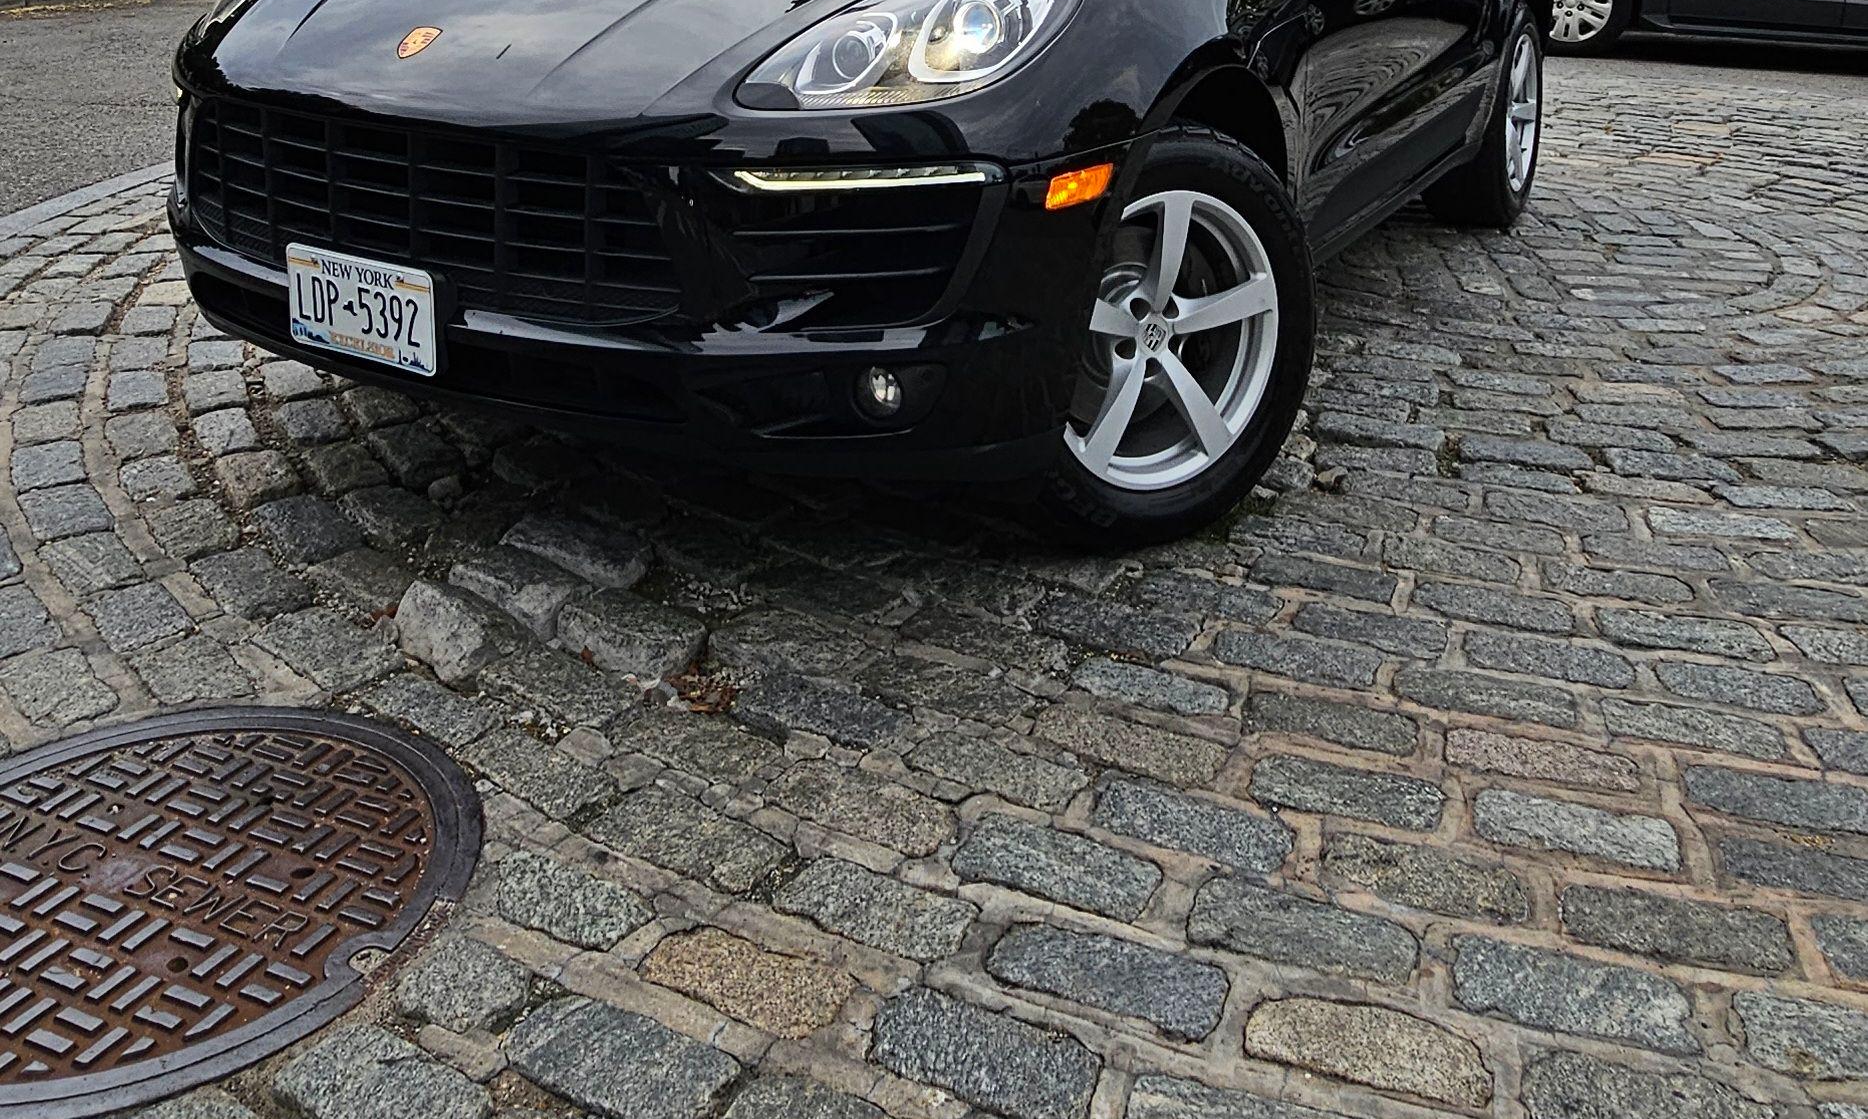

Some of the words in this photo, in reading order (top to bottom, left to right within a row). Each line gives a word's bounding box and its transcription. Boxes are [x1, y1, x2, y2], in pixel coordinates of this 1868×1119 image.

[297, 273, 340, 326] LDP
[357, 286, 421, 348] 5392
[321, 259, 352, 280] NEW
[355, 266, 395, 291] YORK
[0, 816, 106, 871] NYC
[124, 864, 309, 950] SEWER
